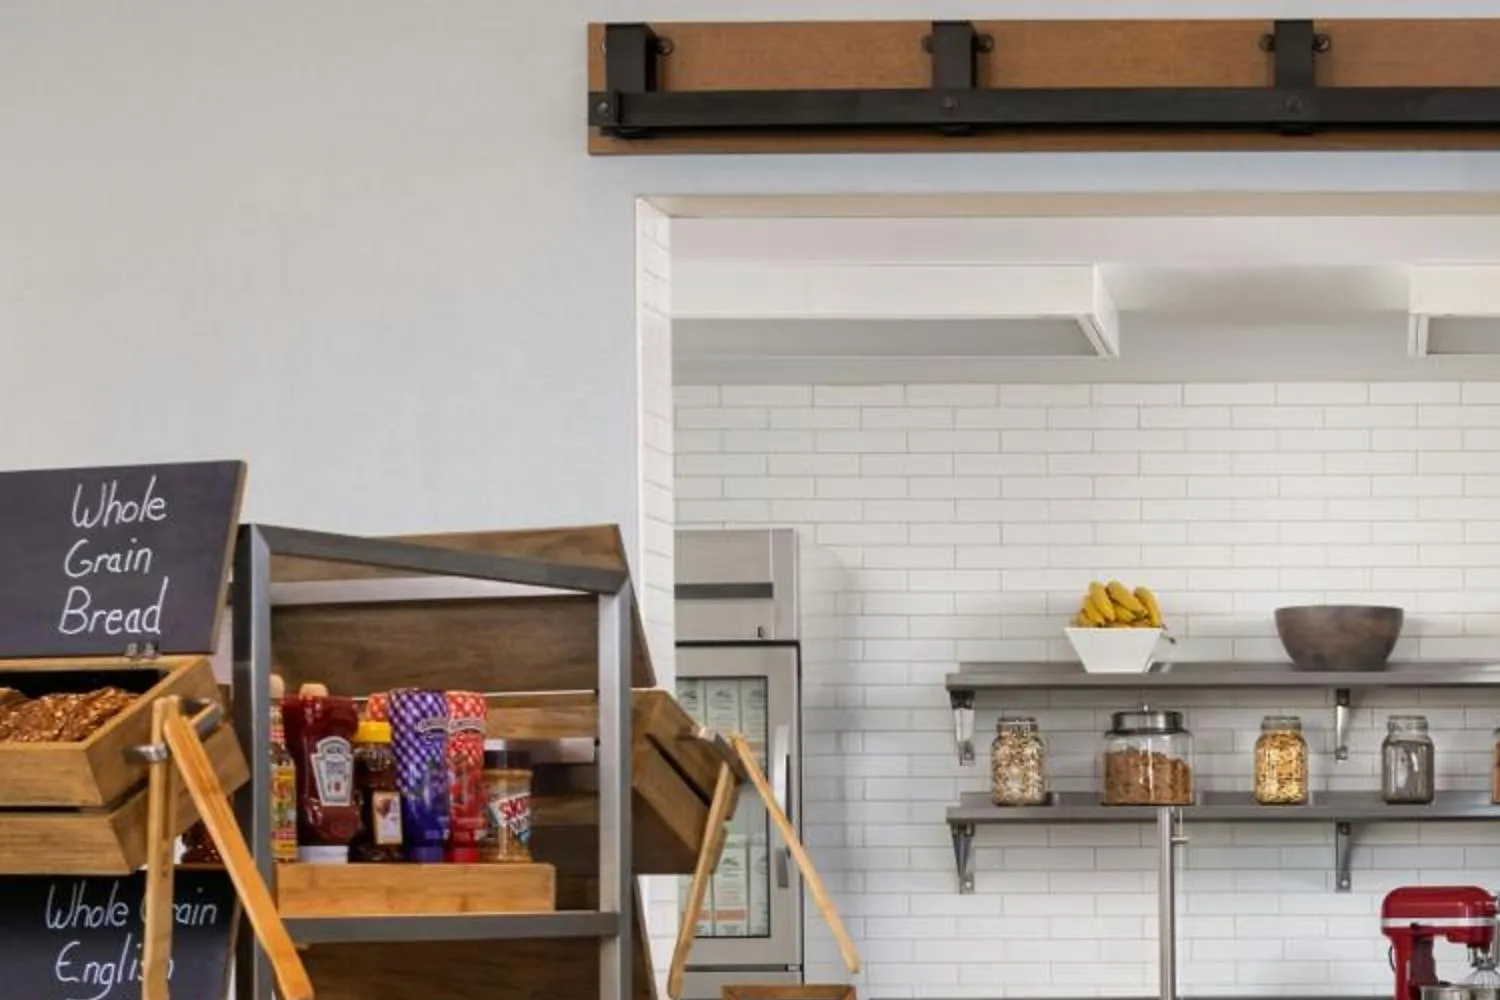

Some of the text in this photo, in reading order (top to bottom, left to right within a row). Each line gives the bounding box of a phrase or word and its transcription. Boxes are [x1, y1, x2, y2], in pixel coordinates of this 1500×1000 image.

[71, 475, 167, 528] Whole
[64, 537, 152, 578] Grain
[58, 576, 169, 634] Bread
[45, 880, 129, 929] Whole
